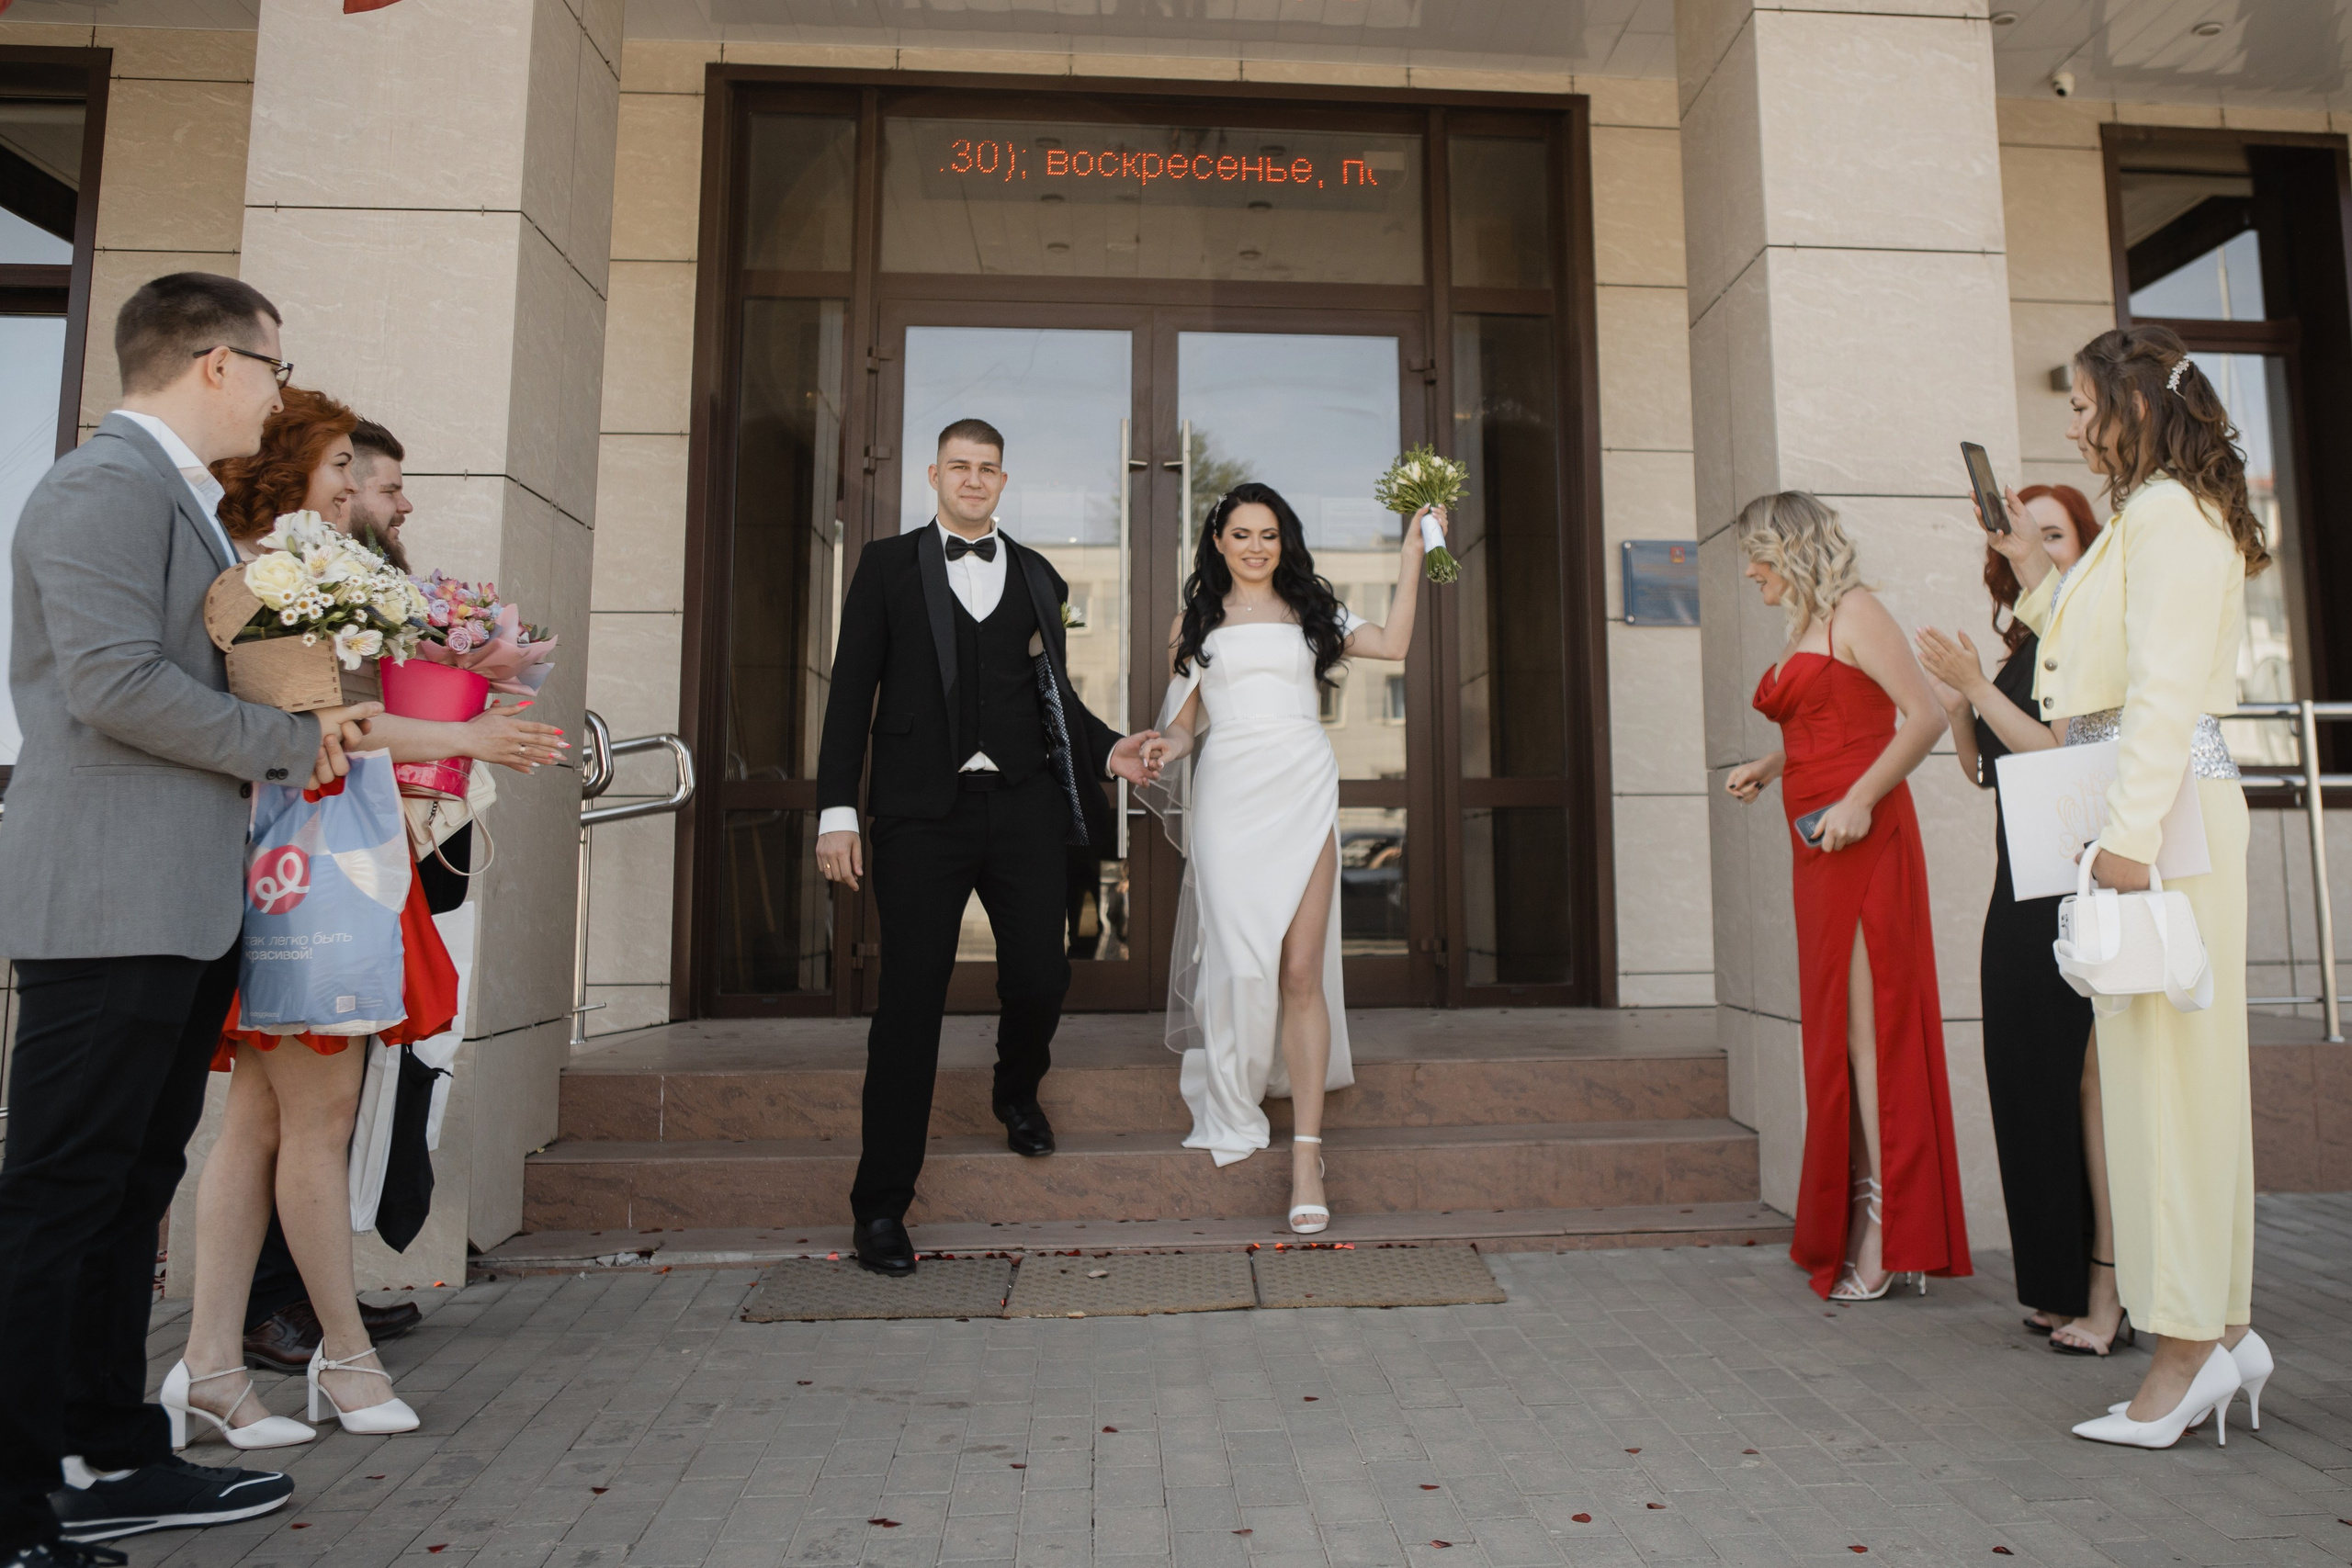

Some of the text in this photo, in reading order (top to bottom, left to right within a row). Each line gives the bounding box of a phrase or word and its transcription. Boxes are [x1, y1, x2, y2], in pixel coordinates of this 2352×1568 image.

[1046, 149, 1324, 189] воскресенье,
[268, 935, 309, 946] легко
[313, 931, 353, 945] быть
[245, 946, 312, 963] красивой!
